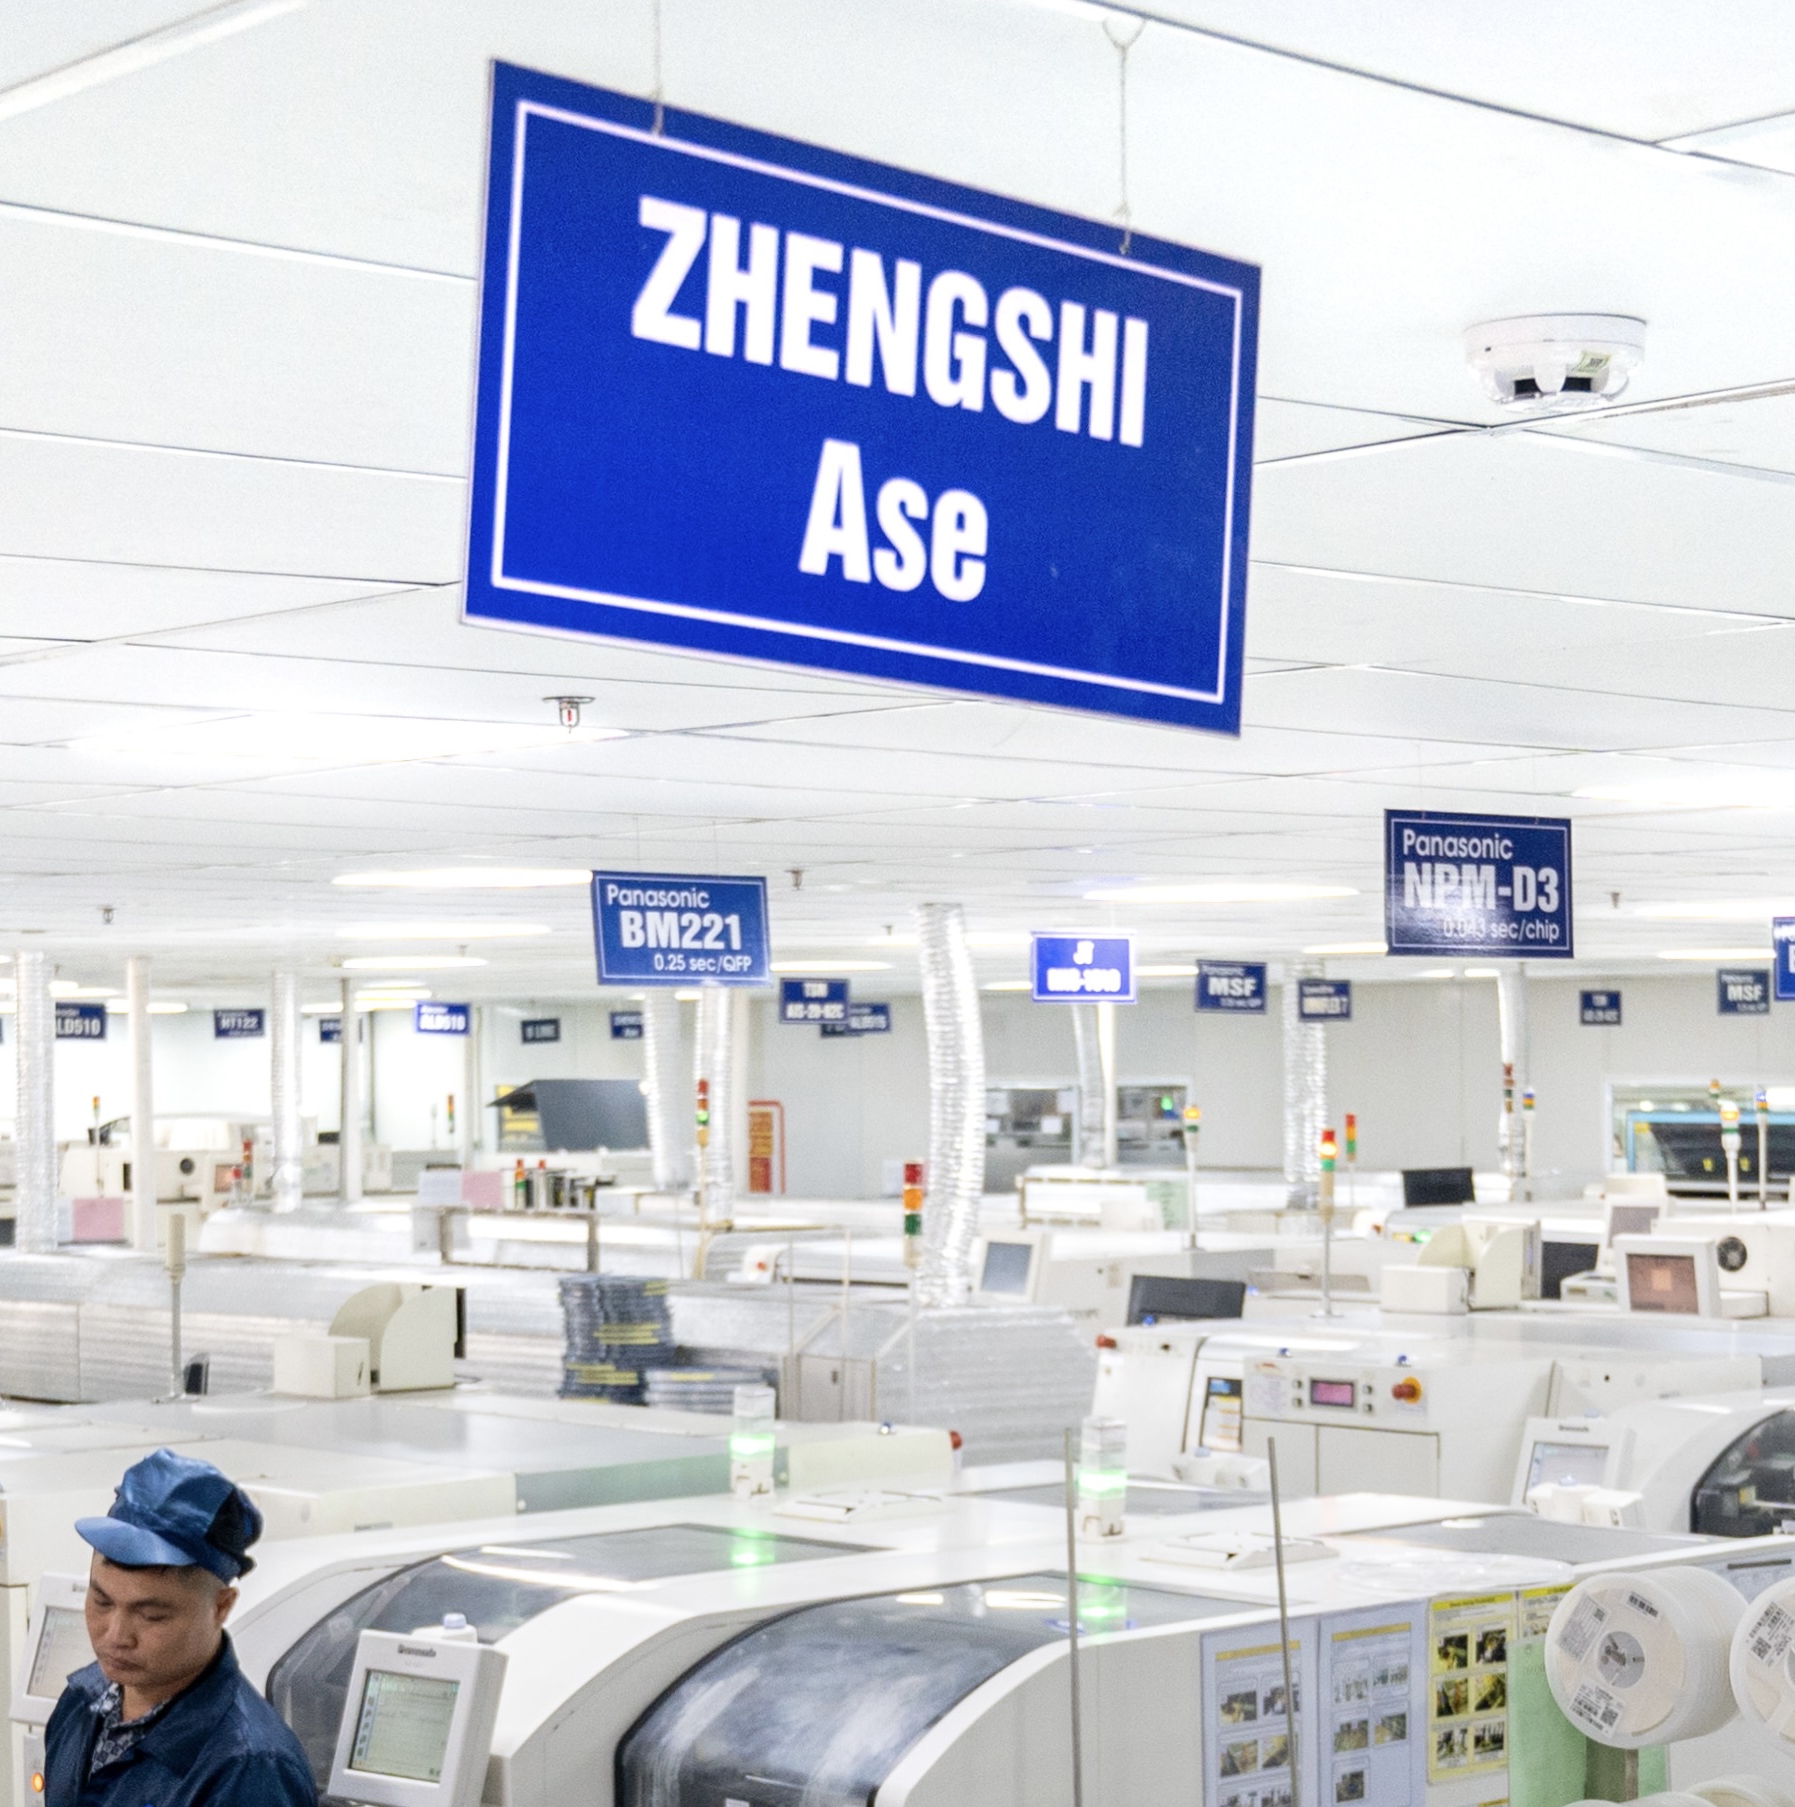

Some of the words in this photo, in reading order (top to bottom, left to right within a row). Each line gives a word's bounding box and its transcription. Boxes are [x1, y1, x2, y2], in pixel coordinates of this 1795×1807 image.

[631, 194, 1149, 448] ZHENGSHI
[799, 438, 989, 603] Ase
[1403, 829, 1514, 860] Panasonic
[607, 884, 710, 909] Panasonic
[1404, 861, 1559, 913] NPM-D3
[619, 911, 742, 950] BM221
[1443, 917, 1486, 938] 0.043
[1490, 919, 1559, 944] sec/chip
[654, 954, 686, 972] 0.25
[689, 955, 753, 974] sec/QFP
[1208, 977, 1256, 997] MSF
[1727, 984, 1762, 1002] MSF
[56, 1017, 101, 1036] LD510
